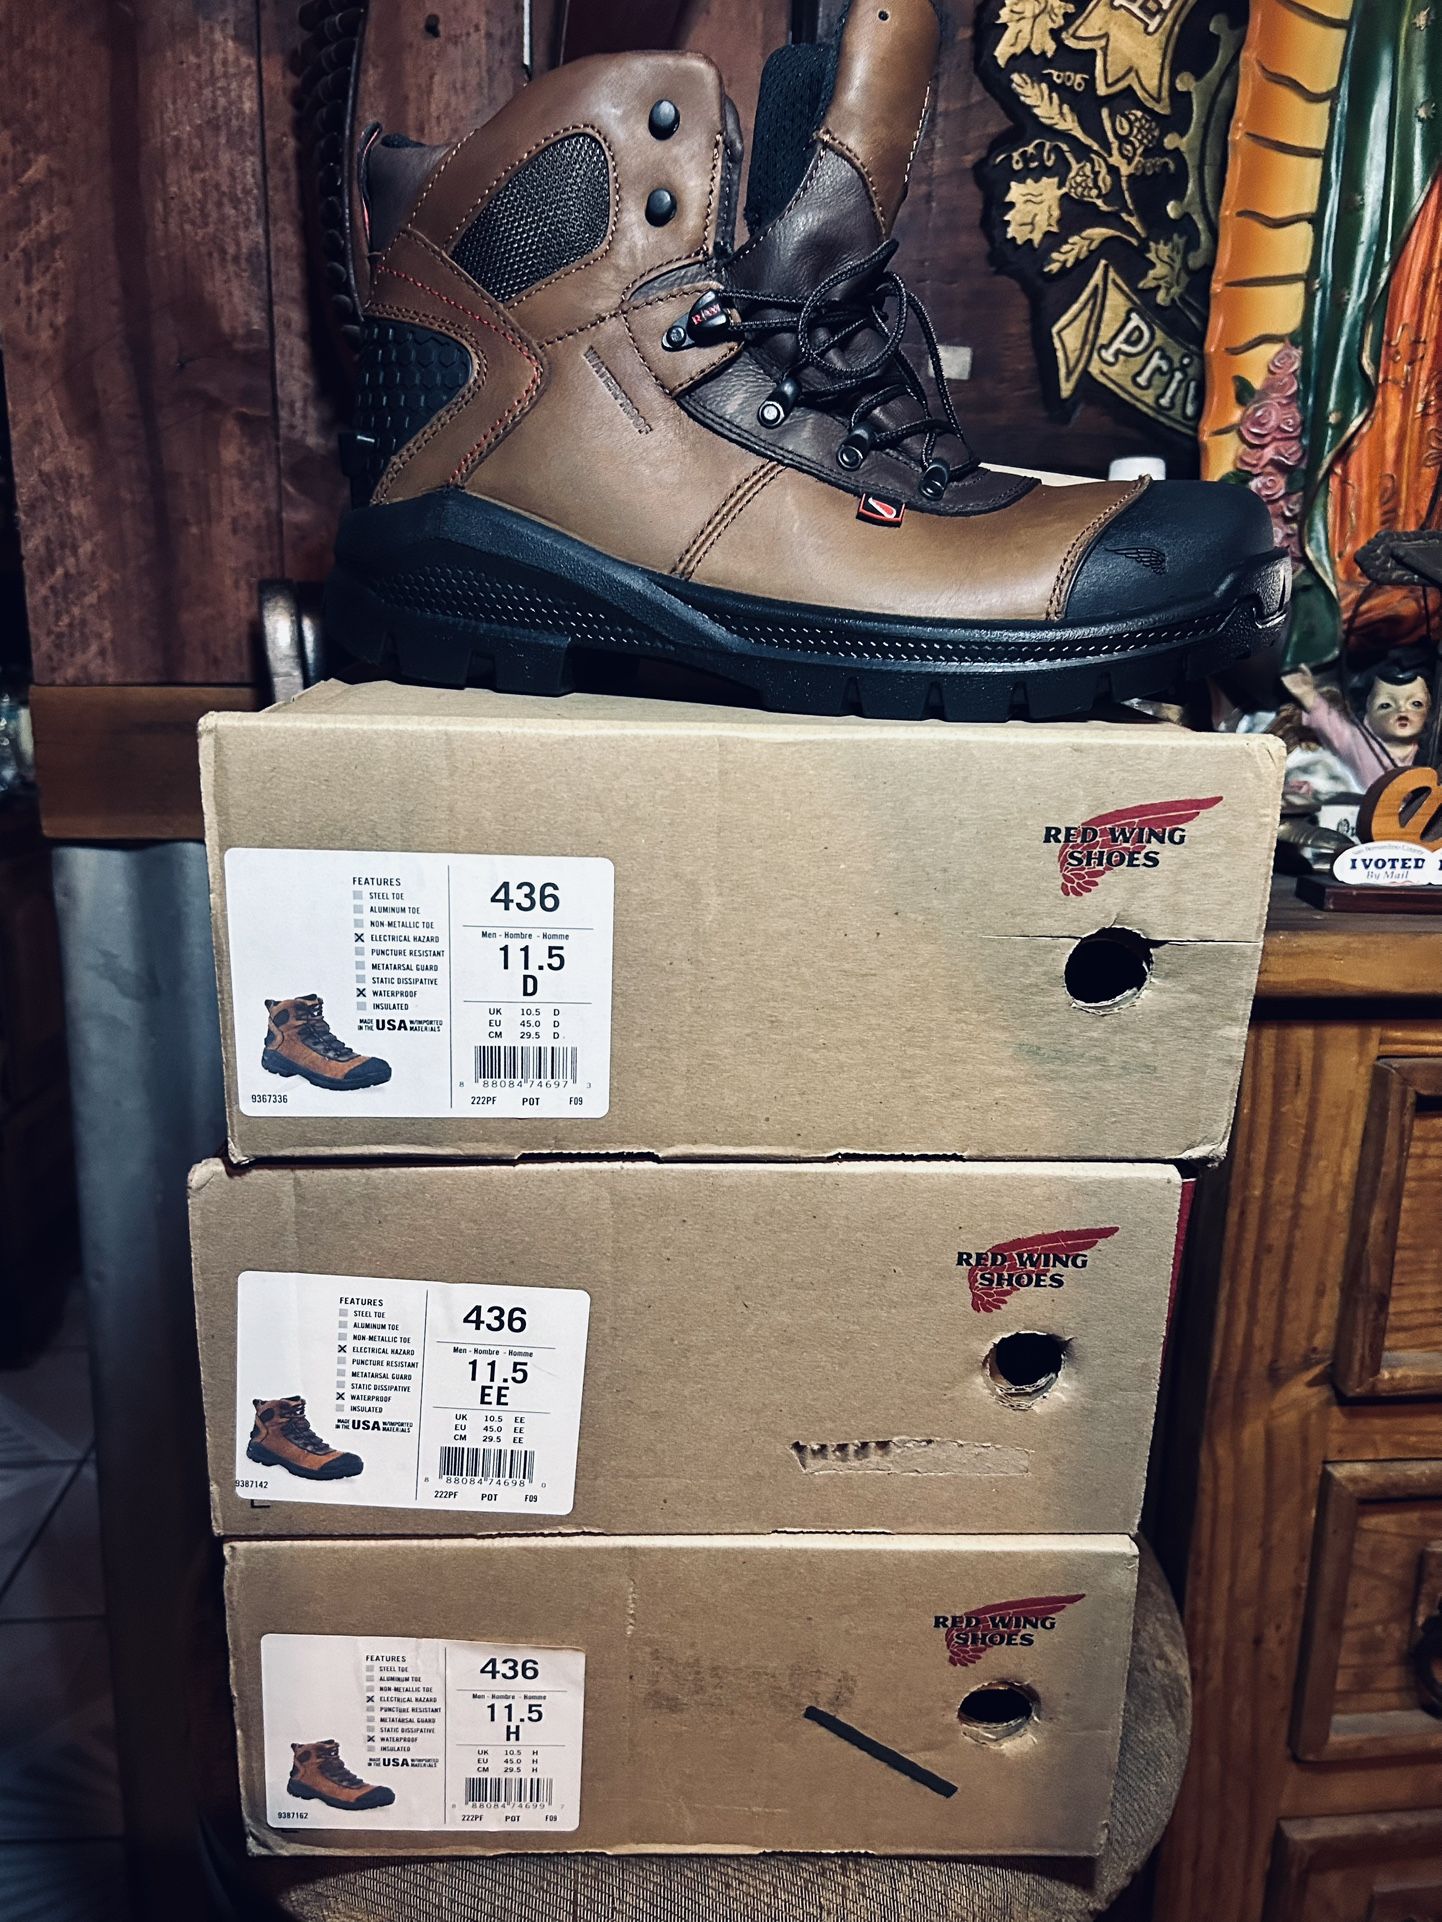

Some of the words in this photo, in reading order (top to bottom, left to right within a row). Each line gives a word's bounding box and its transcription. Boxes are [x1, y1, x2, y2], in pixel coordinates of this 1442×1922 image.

[1043, 826, 1099, 843] RED
[1108, 827, 1186, 845] WING
[1066, 850, 1160, 868] SHOES
[1350, 858, 1357, 869] I
[1361, 858, 1426, 869] VOTED
[1366, 871, 1380, 880] By
[1383, 871, 1409, 879] Mail
[352, 877, 401, 886] FEATURES
[369, 892, 389, 900] STEEL
[490, 881, 560, 912] 436
[369, 906, 406, 914] ALUMINUM
[370, 934, 411, 942] ELECTRICAL
[413, 935, 439, 943] HAZARD
[542, 932, 569, 940] Homme
[499, 944, 565, 971] 11.5
[371, 963, 413, 971] METATARSAL
[522, 974, 538, 996] D
[520, 1008, 541, 1016] 10.5
[375, 1019, 408, 1031] USA
[520, 1020, 541, 1028] 45.0
[553, 1020, 560, 1028] D
[520, 1031, 541, 1039] 29.5
[471, 1096, 497, 1105] 222PF
[522, 1097, 540, 1106] POT
[569, 1097, 583, 1105] F09
[956, 1252, 1007, 1267] RED
[1016, 1252, 1088, 1269] WING
[978, 1273, 1065, 1288] SHOES
[339, 1297, 384, 1306] FEATURES
[463, 1305, 527, 1333] 436
[353, 1322, 386, 1330] ALUMINUM
[352, 1334, 398, 1343] NON-METALLIC
[352, 1346, 389, 1354] ELECTRICAL
[453, 1346, 467, 1354] Men
[473, 1347, 500, 1355] Hombre
[508, 1349, 534, 1357] Homme
[351, 1358, 384, 1366] PUNCTURE
[386, 1360, 419, 1368] RESISTANT
[351, 1371, 389, 1379] METATARSAL
[468, 1359, 528, 1384] 11.5
[373, 1384, 411, 1392] DISSIPATIVE
[350, 1394, 391, 1402] WATERPROOF
[480, 1385, 510, 1406] EE
[350, 1405, 383, 1413] INSULATED
[455, 1413, 468, 1421] UK
[514, 1416, 526, 1424] EE
[352, 1420, 381, 1431] USA
[483, 1425, 503, 1433] 45.0
[482, 1435, 502, 1443] 29.5
[513, 1436, 524, 1444] EE
[434, 1490, 459, 1499] 222PF
[481, 1493, 498, 1501] POT
[524, 1494, 538, 1502] F09
[933, 1615, 981, 1629] RED
[989, 1616, 1056, 1630] WING
[954, 1632, 1034, 1647] SHOES
[479, 1657, 539, 1680] 436
[487, 1703, 543, 1723] 11.5
[505, 1725, 520, 1741] H
